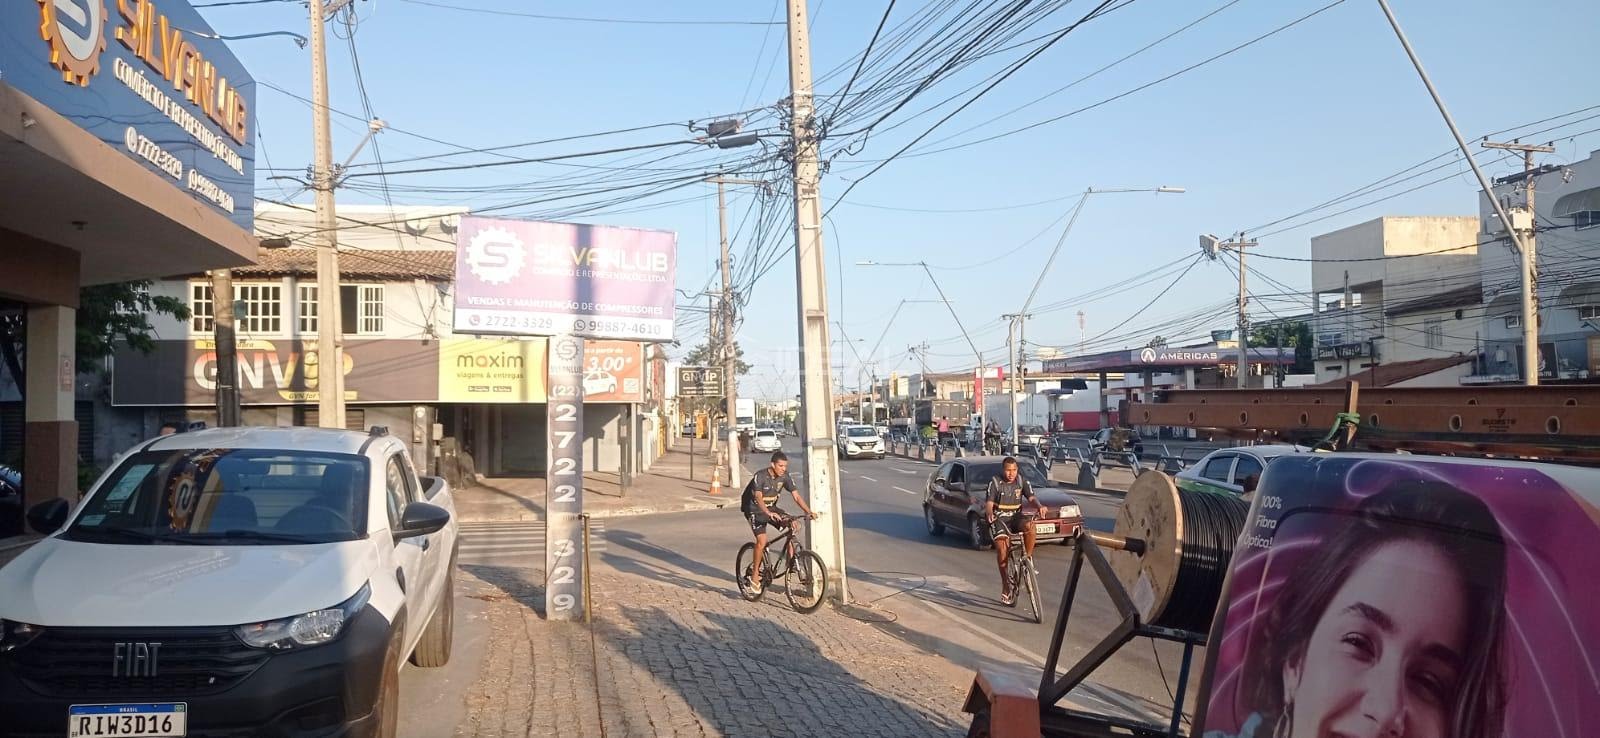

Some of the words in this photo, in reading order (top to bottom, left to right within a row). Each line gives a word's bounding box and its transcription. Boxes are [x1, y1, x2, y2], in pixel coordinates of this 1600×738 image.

[115, 0, 247, 146] SILVANLUB
[137, 135, 183, 180] 2722-3329
[468, 296, 504, 306] VENDAS
[506, 298, 513, 306] E
[514, 297, 579, 310] MANUTENÇÃO
[581, 302, 593, 311] DE
[595, 303, 664, 315] COMPRESSORES
[486, 315, 553, 329] 2722-3329
[589, 320, 662, 335] 99887-4610
[457, 351, 524, 369] maxim
[1160, 351, 1218, 361] AMÉRICAS
[552, 385, 580, 398] (22)
[1256, 515, 1277, 529] Fibra
[112, 642, 163, 678] FIAT
[79, 714, 173, 736] RIW3D16
